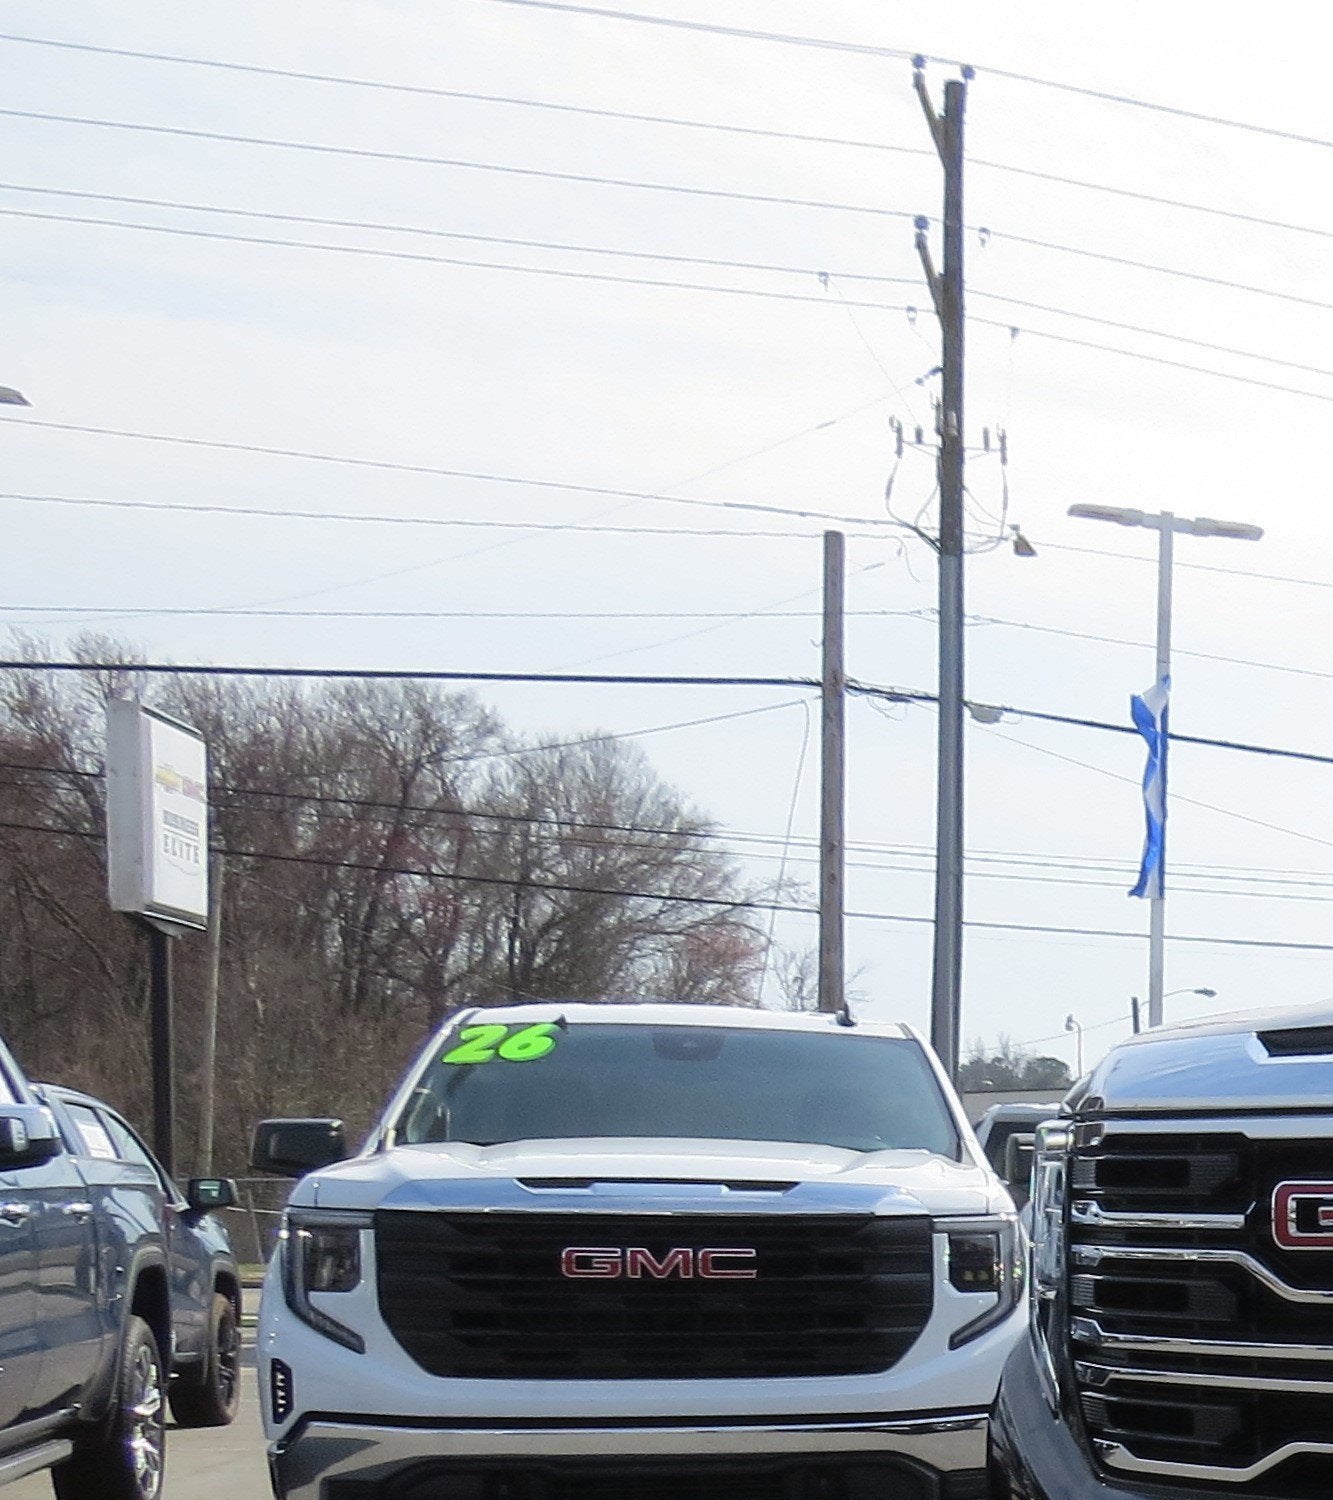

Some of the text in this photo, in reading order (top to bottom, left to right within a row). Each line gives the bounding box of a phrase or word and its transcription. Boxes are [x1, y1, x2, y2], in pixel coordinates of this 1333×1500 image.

[163, 833, 200, 864] ELITE
[441, 1022, 560, 1064] 26
[561, 1247, 758, 1279] GMC
